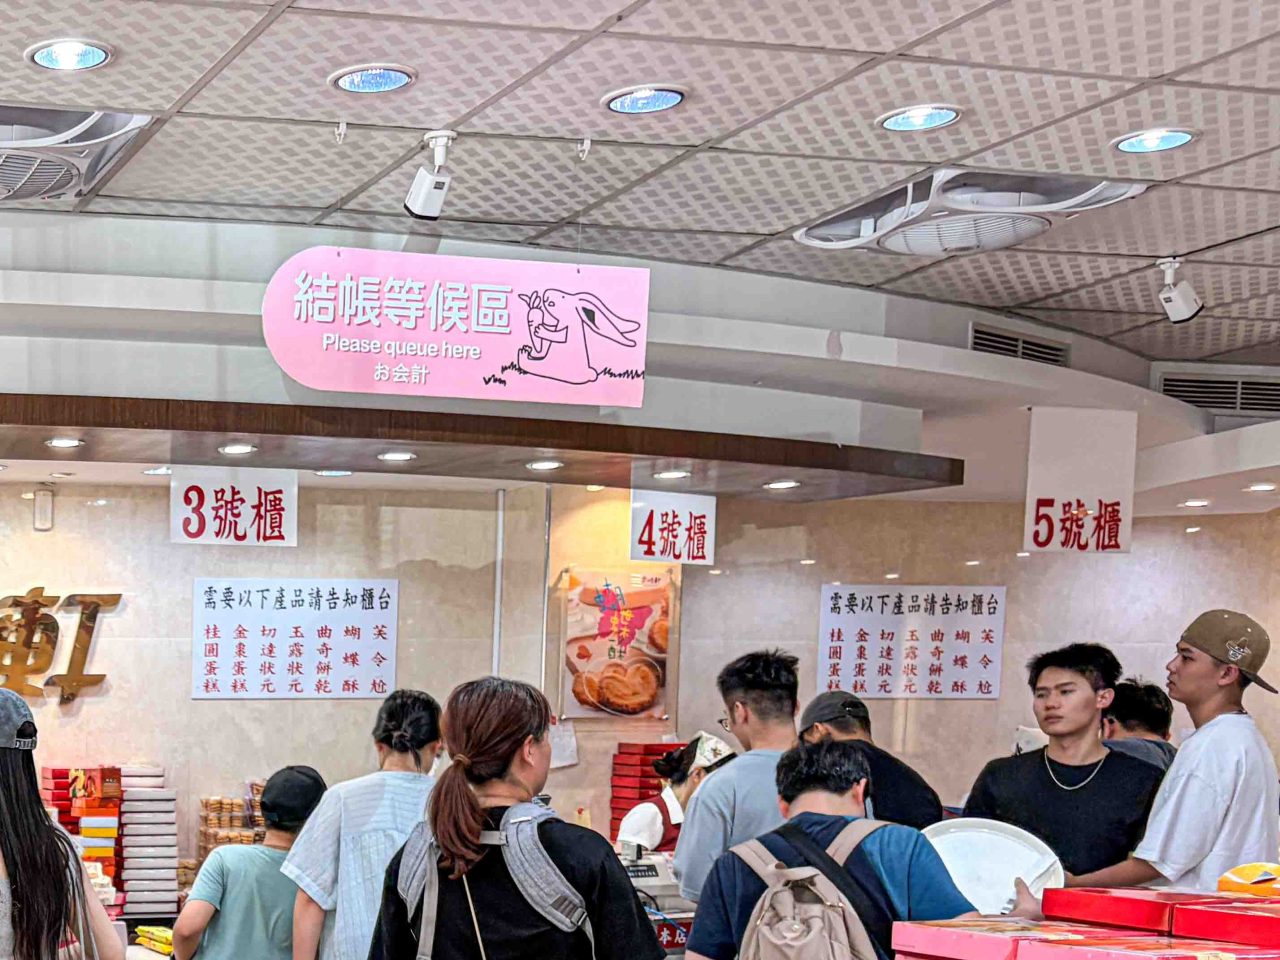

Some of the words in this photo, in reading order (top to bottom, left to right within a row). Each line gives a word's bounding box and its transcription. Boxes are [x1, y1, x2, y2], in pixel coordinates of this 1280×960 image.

[293, 270, 514, 334] 結帳等候區
[322, 333, 382, 353] Please
[384, 338, 439, 358] queue
[442, 341, 482, 360] here
[373, 362, 430, 385] お会計
[182, 484, 286, 542] 3號櫃
[638, 509, 707, 560] 4號櫃
[1033, 498, 1122, 551] 5號櫃
[203, 586, 391, 611] 需要以下產品請告知櫃台
[830, 592, 999, 616] 需要以下產品請告知櫃台
[259, 625, 277, 693] 切達狀元
[342, 625, 361, 693] 蝴蝶酥
[951, 630, 970, 693] 蝴蝶酥
